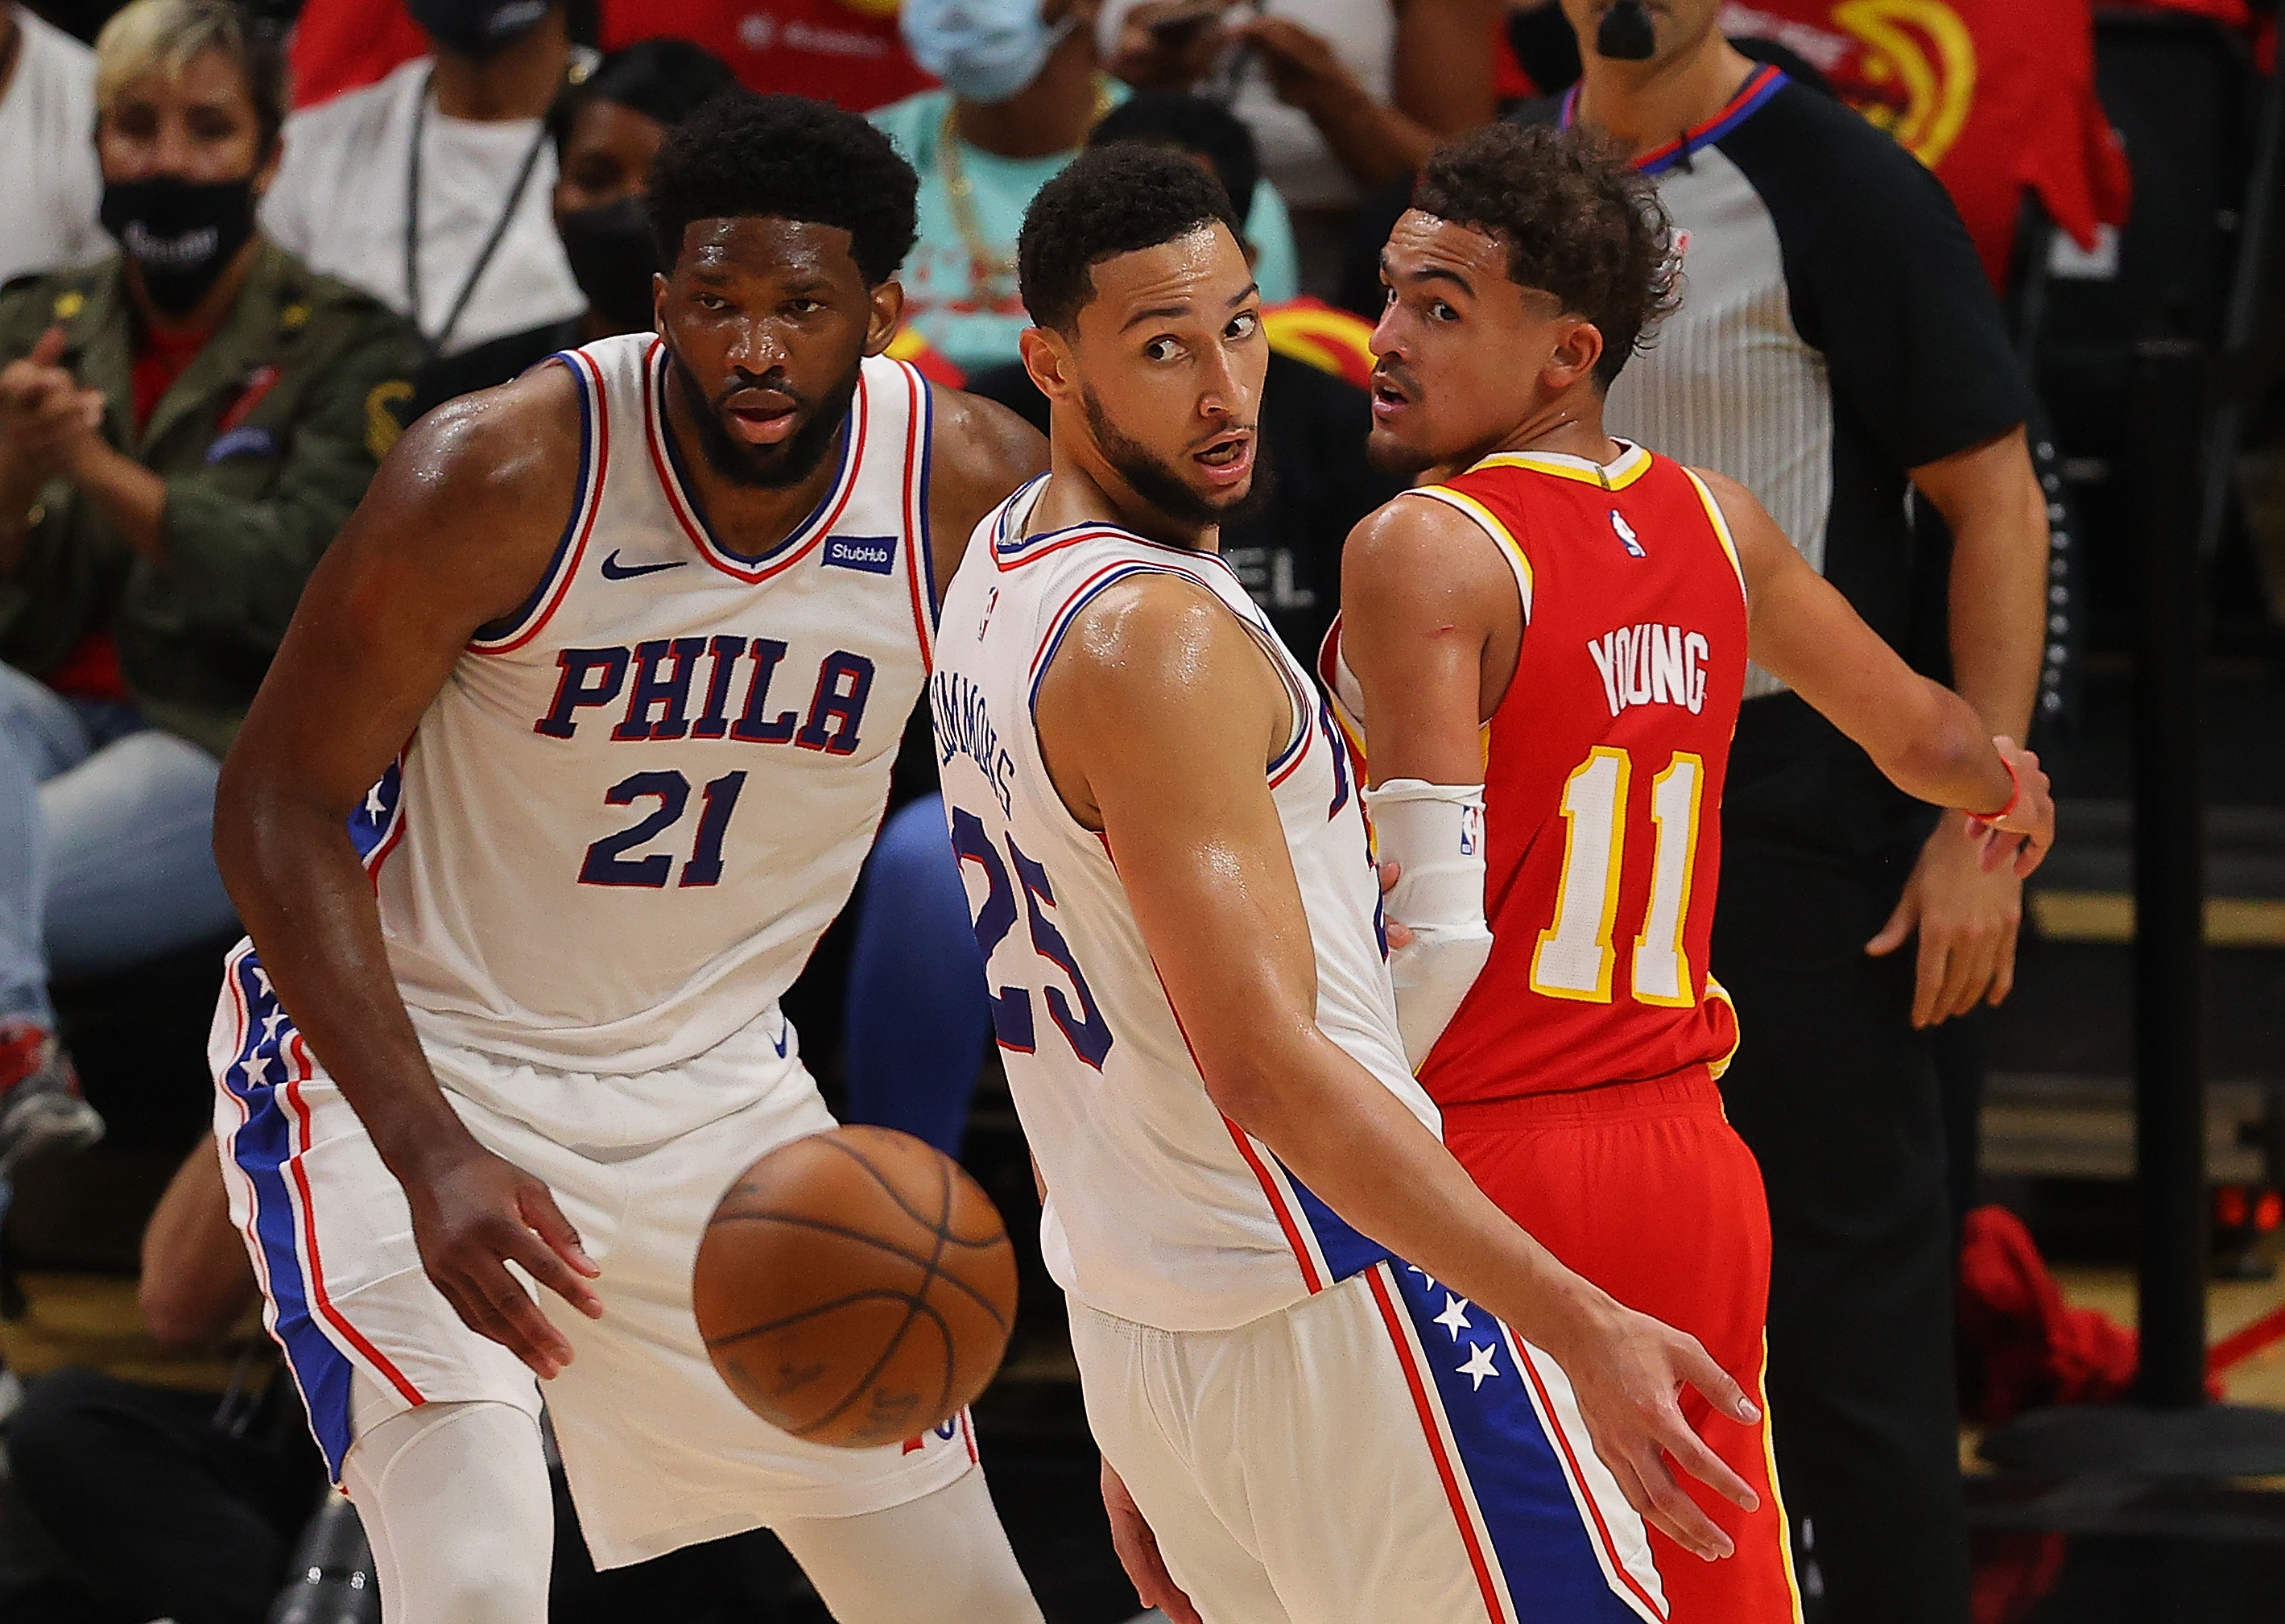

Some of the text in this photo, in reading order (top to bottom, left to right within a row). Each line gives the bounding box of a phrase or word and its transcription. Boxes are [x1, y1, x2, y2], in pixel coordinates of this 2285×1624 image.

[832, 543, 887, 562] StubHub
[534, 634, 875, 755] PHILA
[1587, 623, 1709, 717] YOUNG
[577, 770, 748, 888] 21
[1529, 746, 1704, 1008] 11
[951, 805, 1114, 1075] 25
